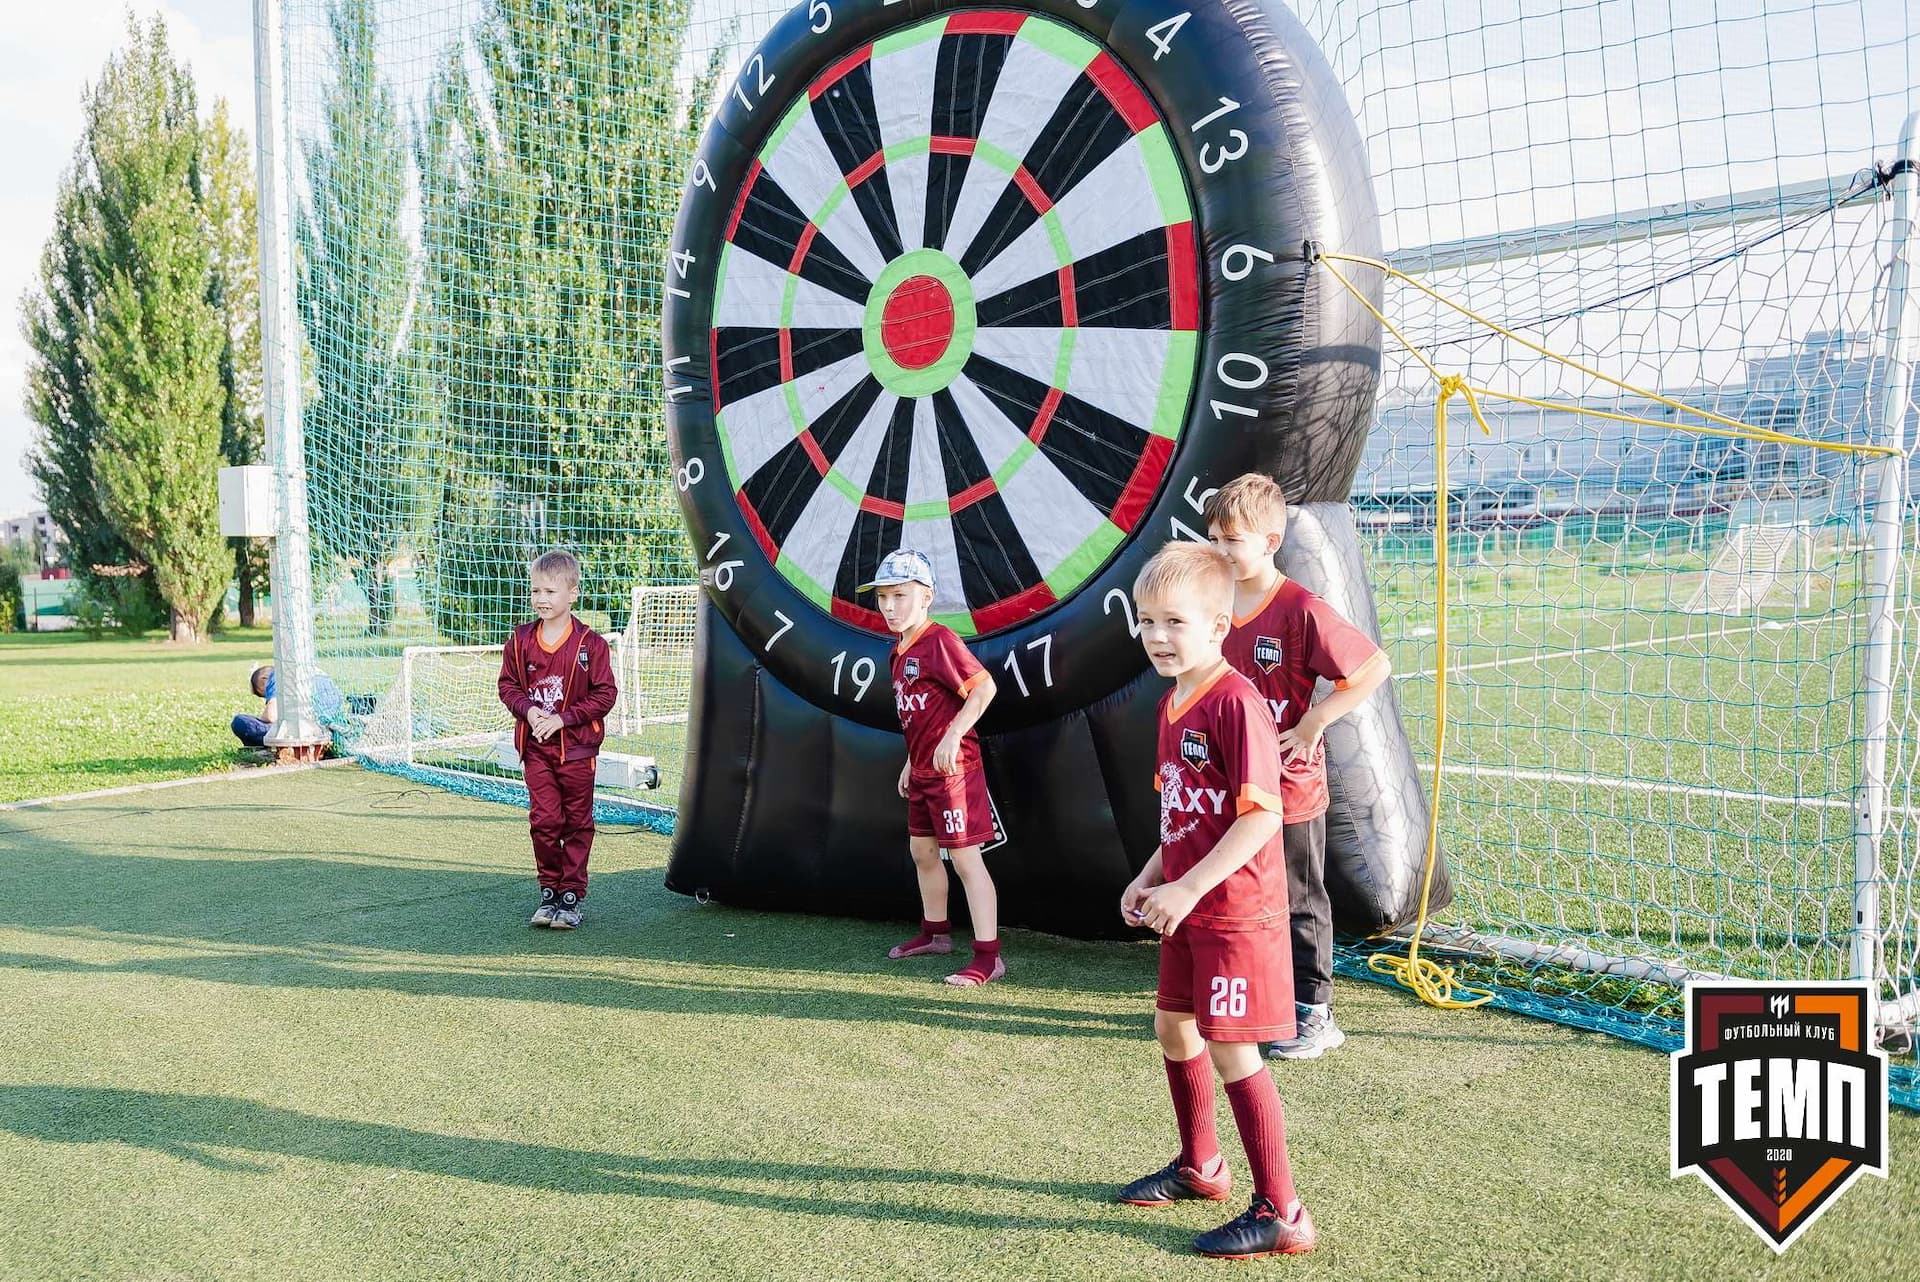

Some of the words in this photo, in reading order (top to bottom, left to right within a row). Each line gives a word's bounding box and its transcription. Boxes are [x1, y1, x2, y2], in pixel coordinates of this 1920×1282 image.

[808, 0, 833, 34] 5
[1145, 11, 1192, 61] 4
[732, 53, 776, 112] 12
[1190, 96, 1249, 174] 13
[666, 249, 696, 300] 14
[665, 355, 693, 403] 11
[1209, 352, 1269, 420] 10
[678, 457, 705, 492] 8
[706, 531, 744, 592] 16
[764, 610, 794, 652] 7
[830, 650, 876, 703] 19
[1003, 633, 1054, 697] 17
[943, 808, 966, 834] 33
[1209, 976, 1248, 1018] 26
